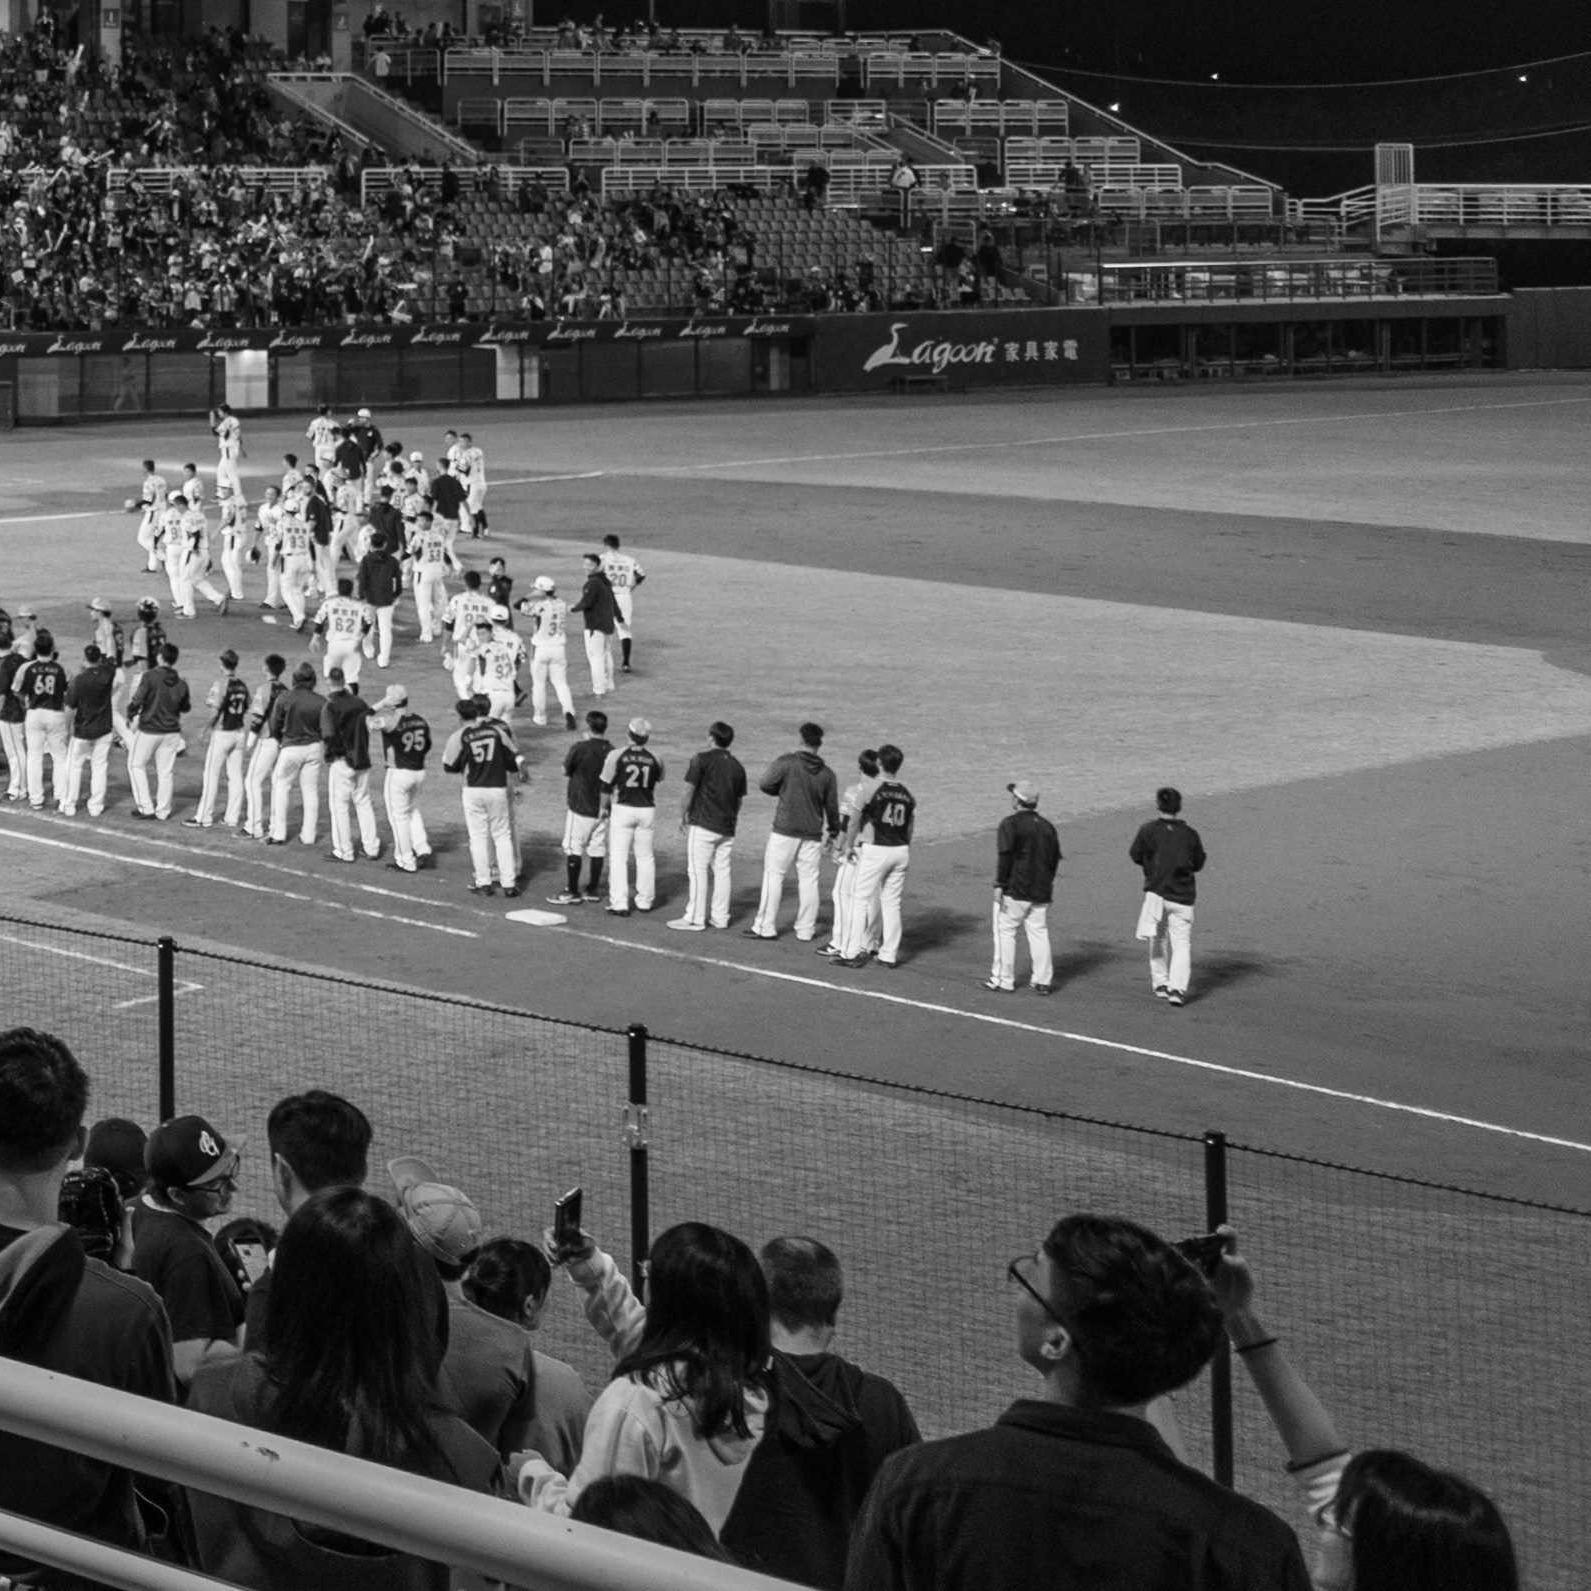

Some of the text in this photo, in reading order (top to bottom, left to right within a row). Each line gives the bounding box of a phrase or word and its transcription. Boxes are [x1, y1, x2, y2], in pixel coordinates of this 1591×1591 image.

[863, 322, 1079, 374] Lagoon 家具家電
[34, 673, 56, 696] 68
[400, 728, 426, 753] 95
[469, 737, 496, 764] 57
[624, 764, 650, 789] 21
[880, 802, 906, 827] 40
